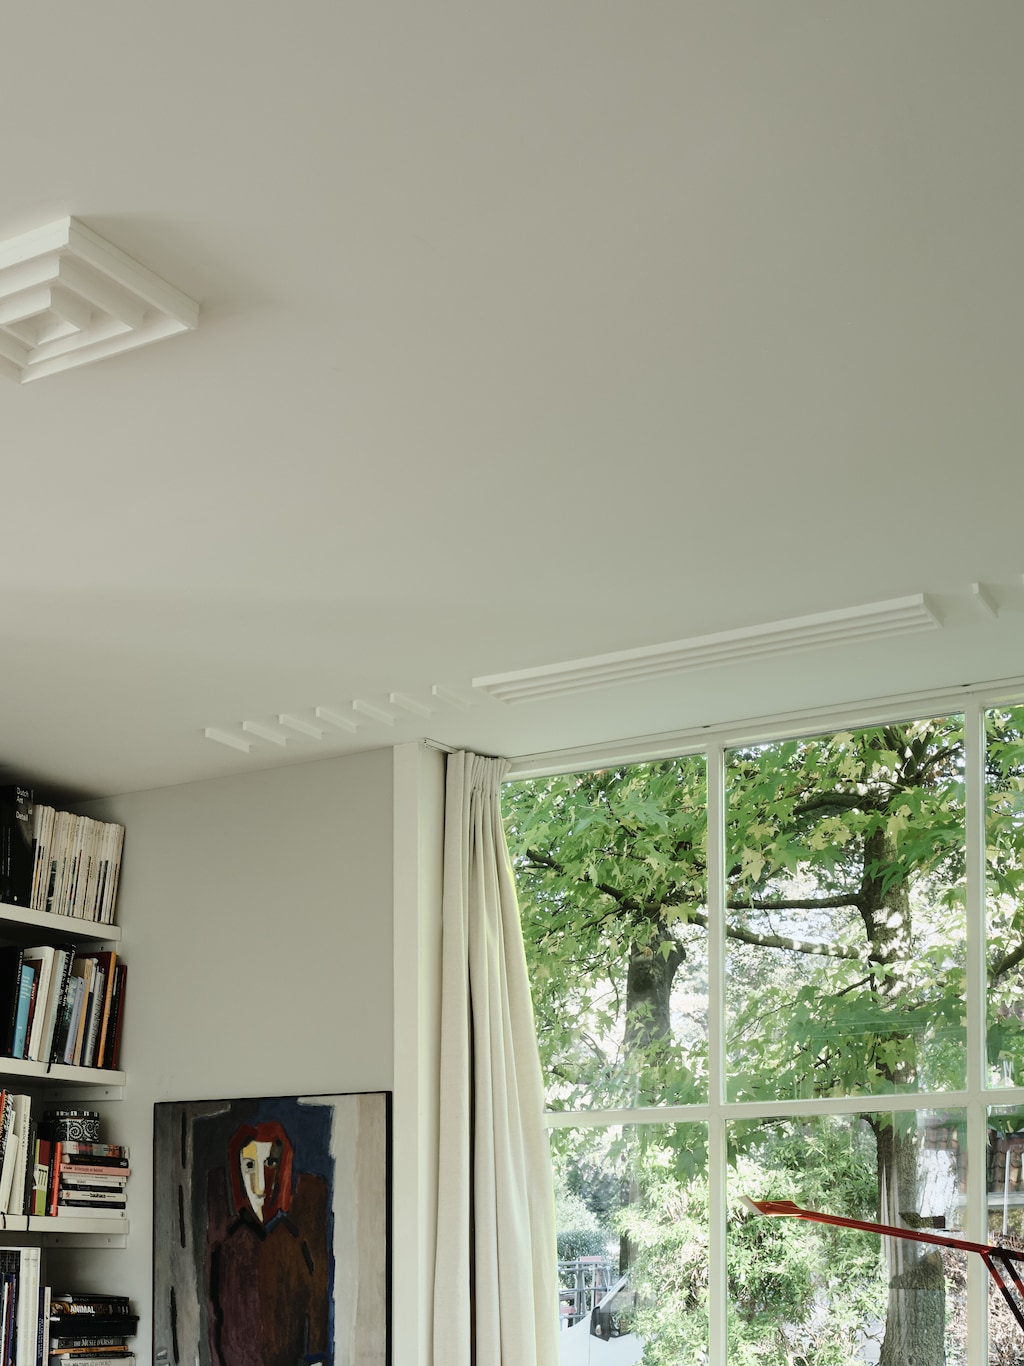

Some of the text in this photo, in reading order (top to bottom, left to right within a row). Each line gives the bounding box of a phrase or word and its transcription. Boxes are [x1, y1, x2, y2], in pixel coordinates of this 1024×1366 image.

[16, 787, 29, 798] Dutch
[16, 810, 28, 821] Detail
[70, 1304, 95, 1313] ANIMAL
